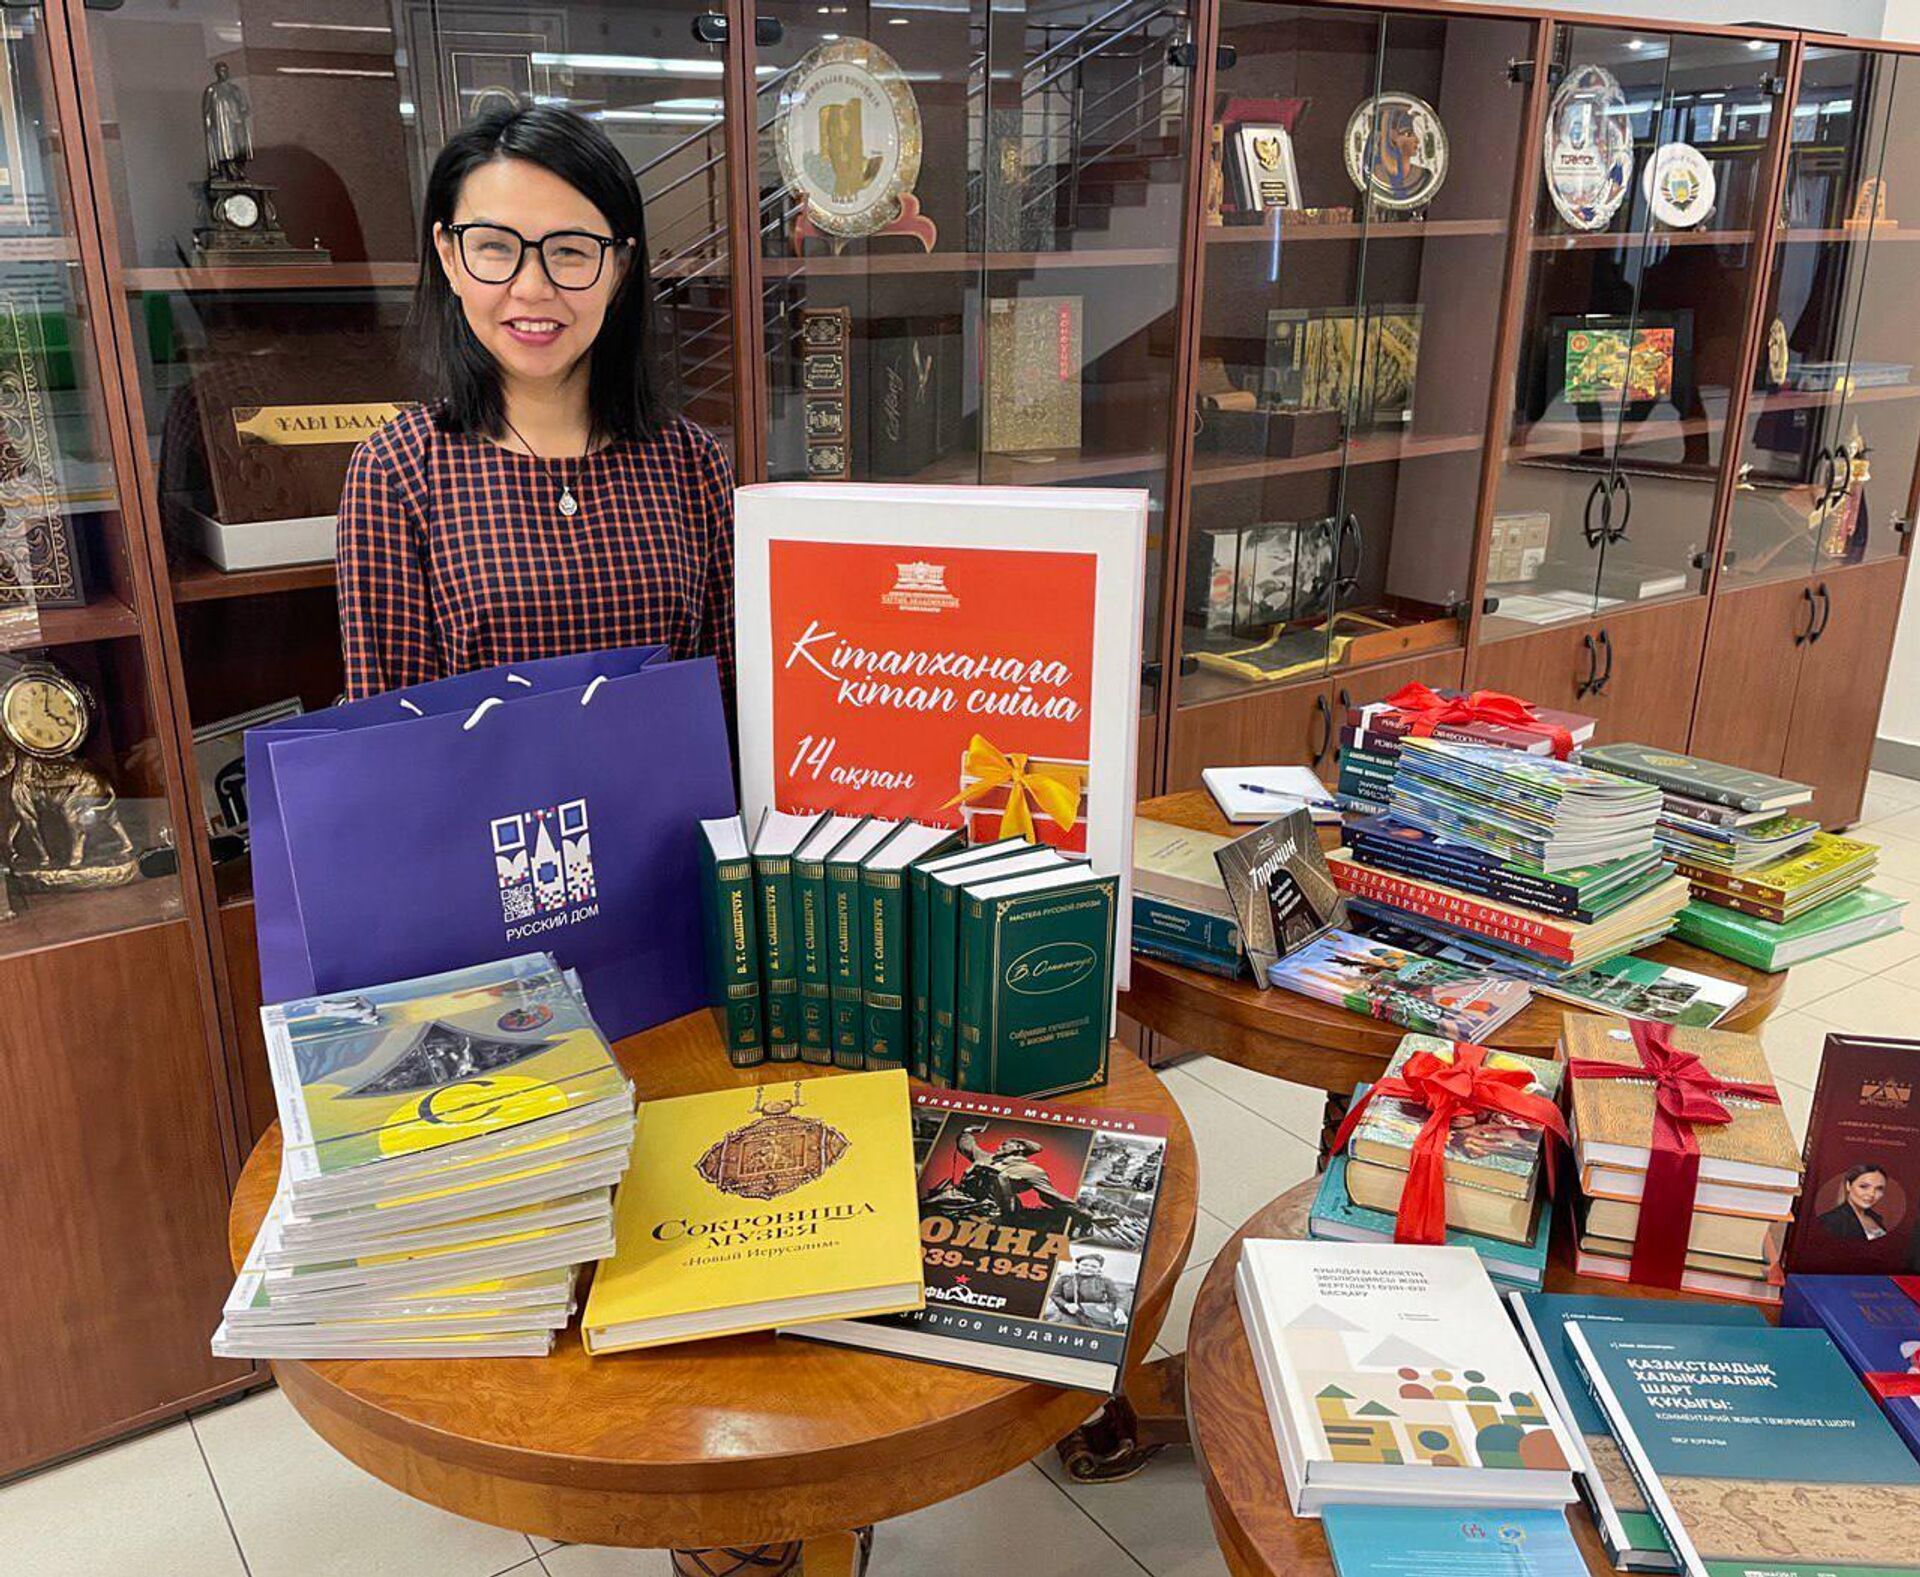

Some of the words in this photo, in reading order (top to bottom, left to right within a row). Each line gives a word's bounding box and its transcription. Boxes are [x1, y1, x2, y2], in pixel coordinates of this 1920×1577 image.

[785, 620, 1073, 688] Кітапханаға
[837, 675, 958, 713] кітап
[789, 735, 836, 779] 14
[830, 765, 915, 790] ақпан
[1341, 864, 1471, 914] УВЛЕКАТЕЛЬНЫЕ
[1478, 908, 1544, 937] СКАЗКИ
[505, 912, 568, 942] РУССКИЙ
[571, 903, 600, 925] ДОМ
[917, 1095, 1012, 1115] Владимир
[1024, 1108, 1136, 1130] Мединский
[707, 1223, 818, 1249] МУЗЕЯ
[920, 1215, 1073, 1261] ОЙНА
[921, 1246, 1048, 1281] 39-1945
[1626, 1358, 1777, 1376] ҚАЗАҚСТАНДЫҚ
[1634, 1371, 1778, 1389] ХАЛЫҚАРАЛЫҚ
[1640, 1383, 1693, 1396] ШАРТ
[1655, 1412, 1731, 1423] КОММЕНТАРИЙ
